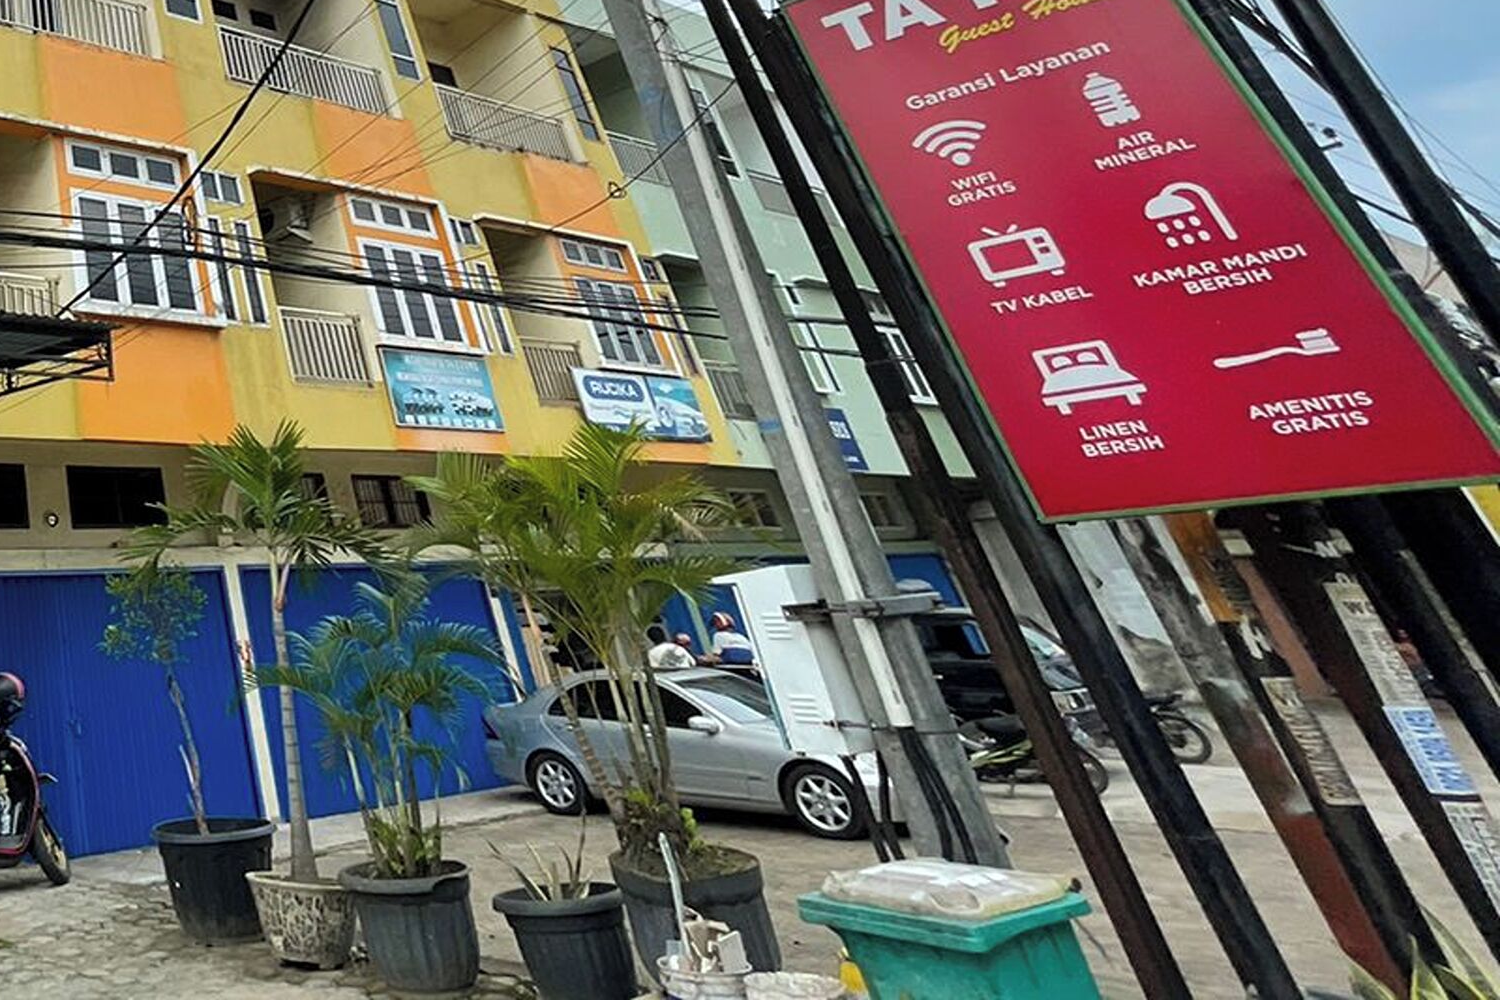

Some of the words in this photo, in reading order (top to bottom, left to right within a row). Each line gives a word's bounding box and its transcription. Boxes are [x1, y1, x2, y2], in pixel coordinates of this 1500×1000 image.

[939, 13, 1015, 53] Guest
[905, 74, 996, 111] Garansi
[1001, 40, 1111, 83] Layanan
[1094, 137, 1196, 171] MINERAL
[1117, 130, 1156, 150] AIR
[947, 179, 1016, 207] GRATIS
[951, 171, 997, 191] WIFI
[1133, 260, 1218, 289] KAMAR
[1221, 243, 1307, 272] MANDI
[1184, 268, 1271, 294] BERSIH
[991, 299, 1019, 315] TV
[1022, 286, 1092, 310] KABEL
[1248, 390, 1373, 422] AMENITIS
[1079, 419, 1149, 442] LINEN
[1271, 409, 1370, 437] GRATIS
[1081, 434, 1164, 460] BERSIH
